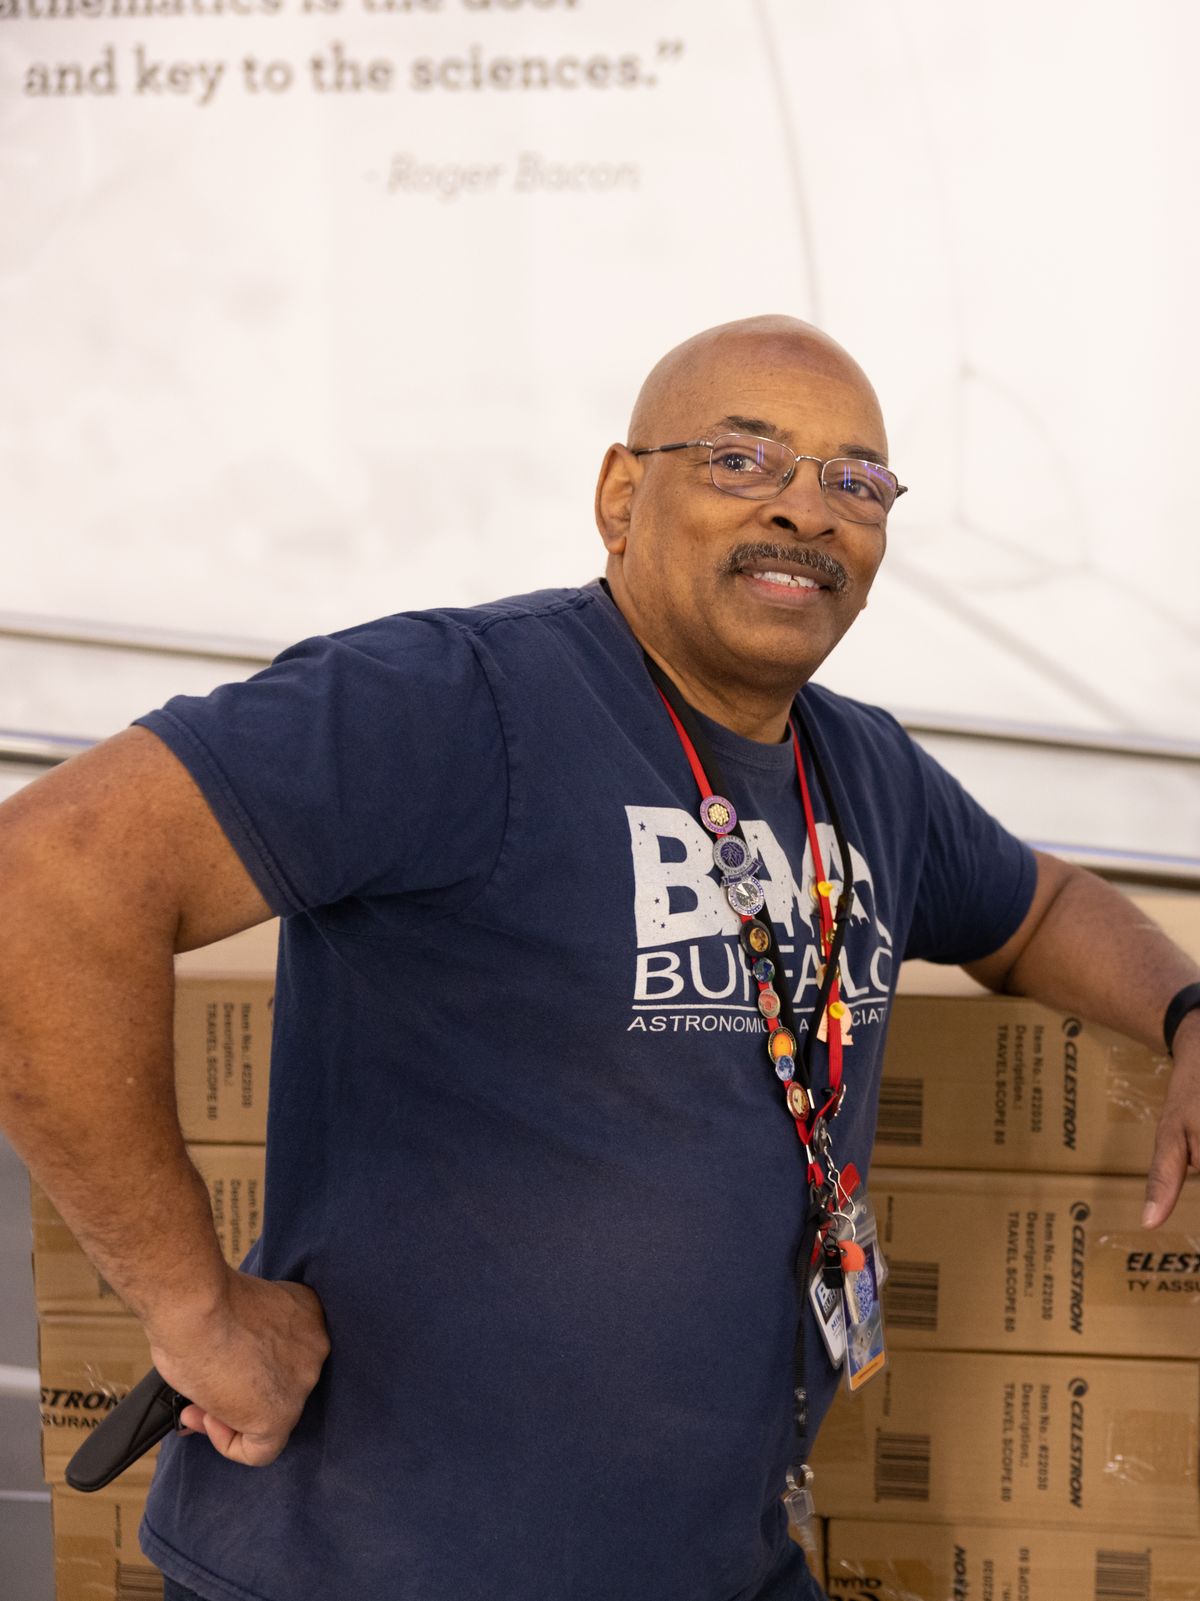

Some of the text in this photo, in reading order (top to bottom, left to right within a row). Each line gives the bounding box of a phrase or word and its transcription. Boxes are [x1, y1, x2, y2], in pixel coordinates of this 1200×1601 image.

[24, 43, 117, 95] and
[134, 42, 223, 106] key
[243, 52, 295, 93] to
[308, 40, 394, 92] the
[387, 149, 506, 205] Roger
[514, 148, 641, 193] Bacon
[1064, 1041, 1078, 1150] CELESTRON
[1004, 1211, 1019, 1333] TRAVEL SCOPE 80
[1070, 1224, 1085, 1335] CELESTRON
[1127, 1280, 1149, 1292] TY
[1003, 1383, 1015, 1434] TRAVEL
[1001, 1438, 1013, 1484] SCOPE
[1069, 1400, 1084, 1509] CELESTRON
